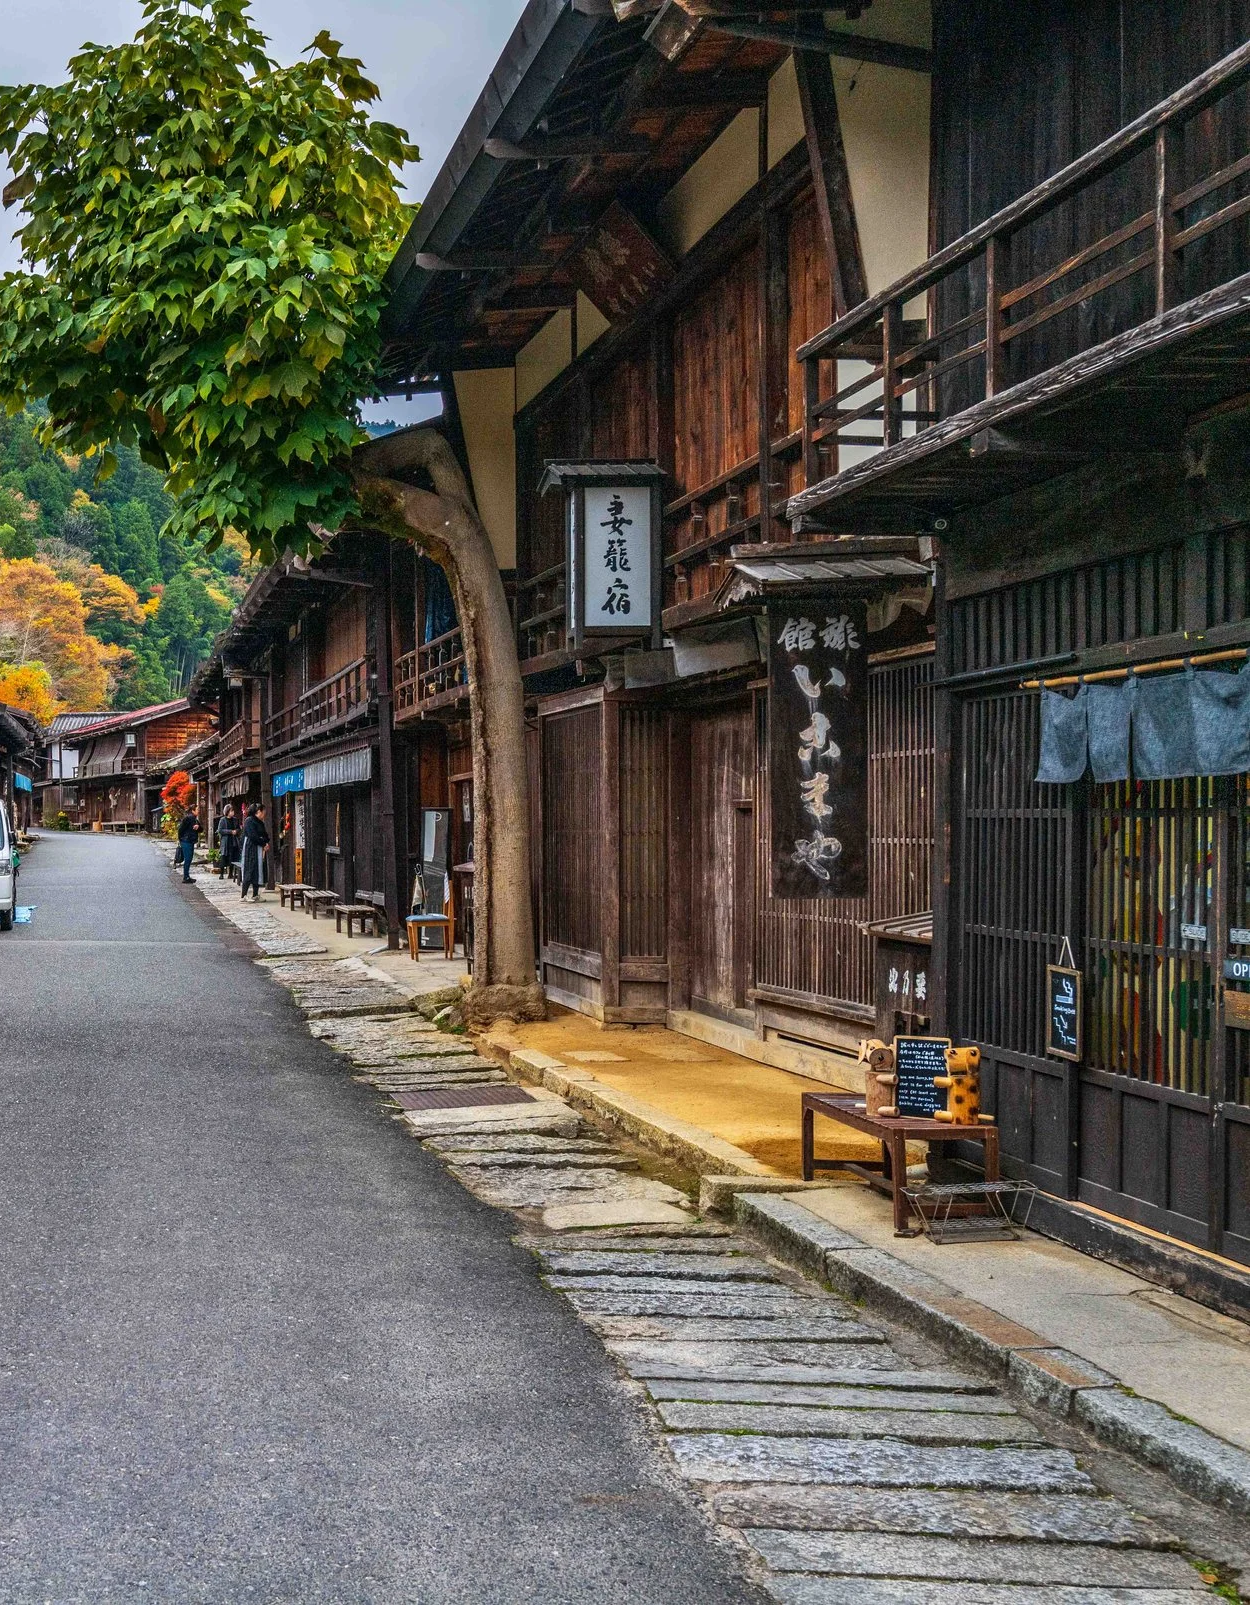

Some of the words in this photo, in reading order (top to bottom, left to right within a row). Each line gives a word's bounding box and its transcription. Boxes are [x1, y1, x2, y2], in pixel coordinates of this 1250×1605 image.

[600, 494, 633, 615] 妻籠宿
[1233, 962, 1250, 978] OP
